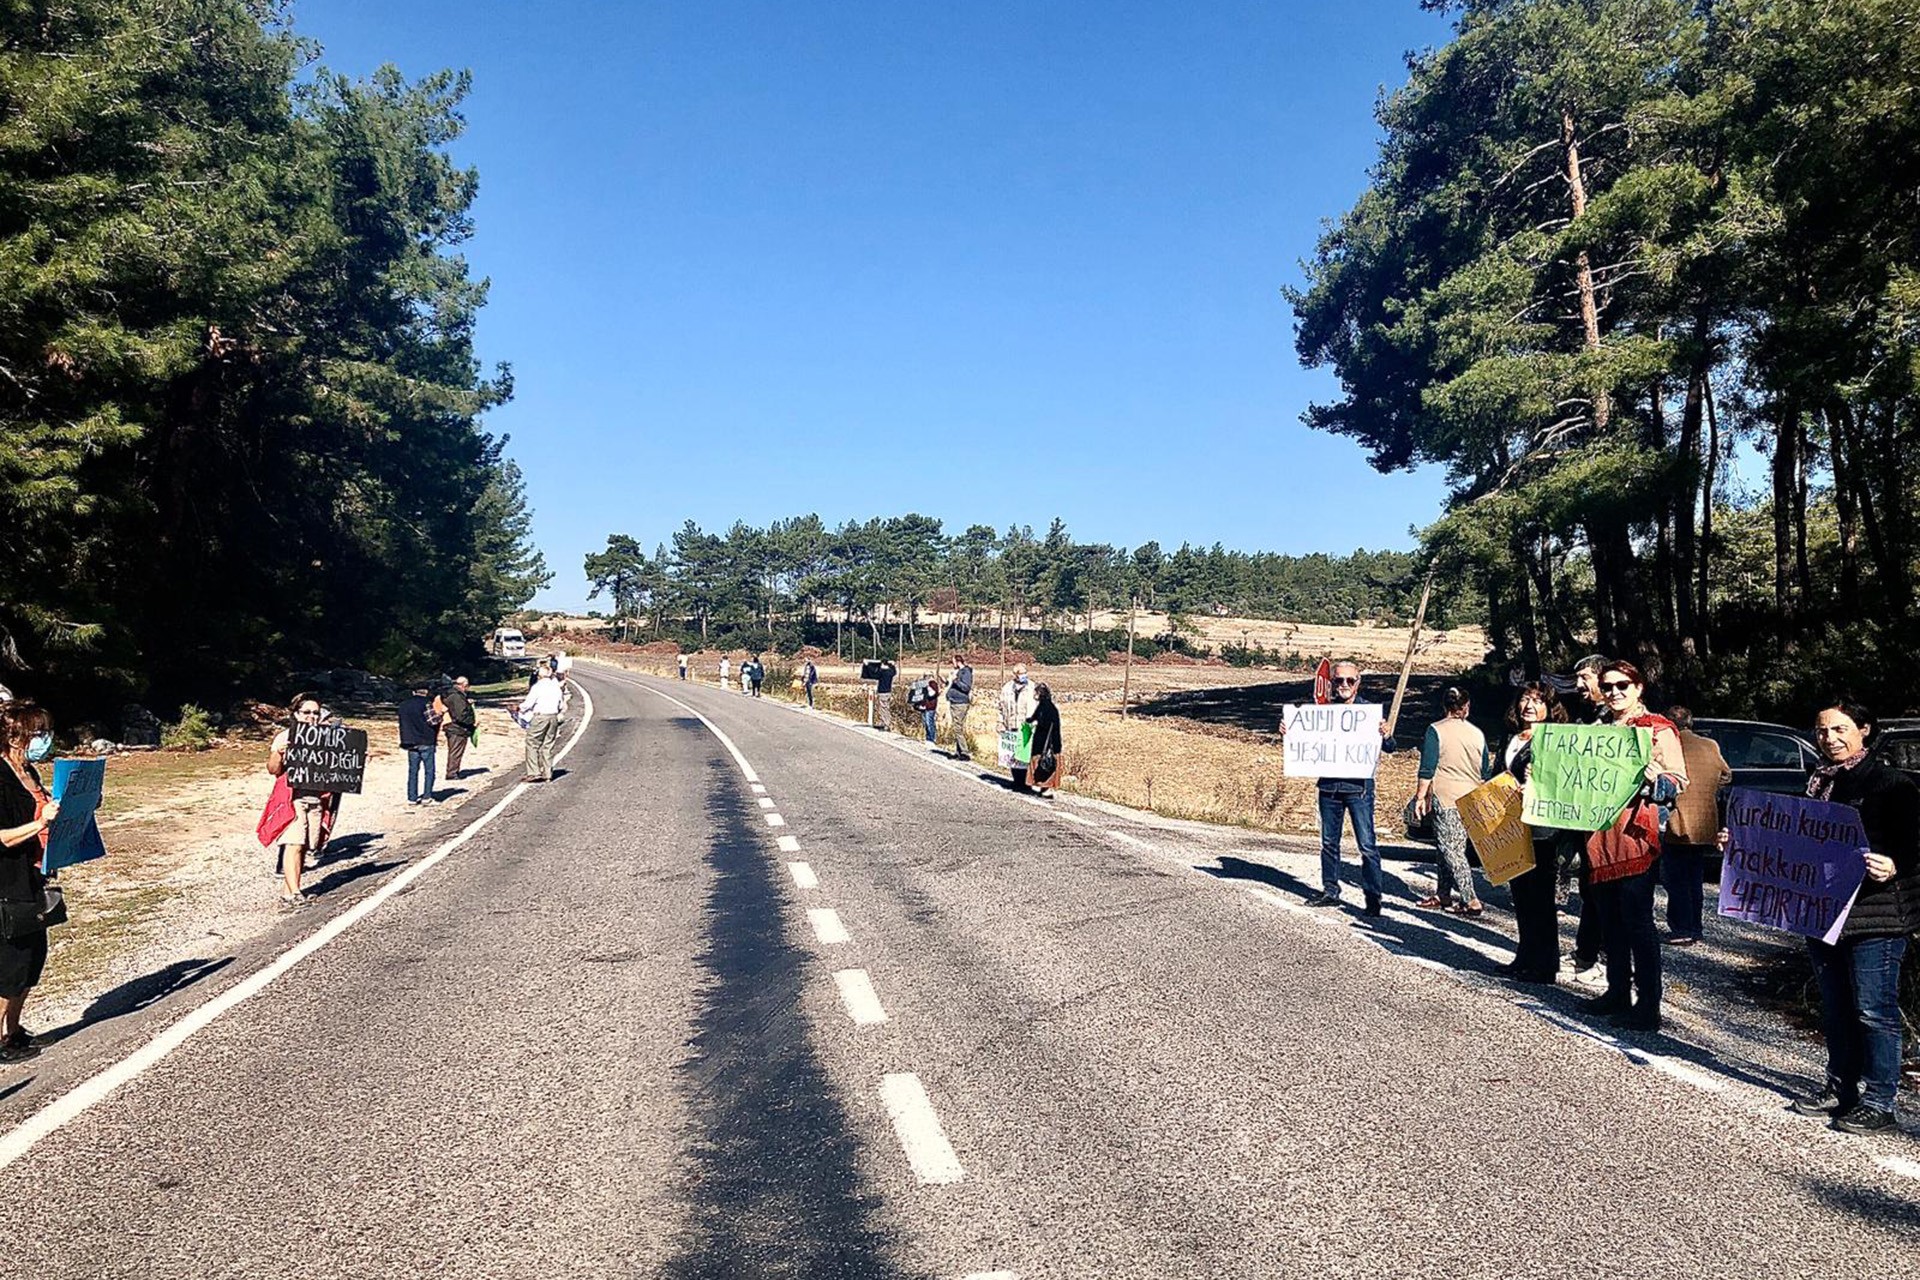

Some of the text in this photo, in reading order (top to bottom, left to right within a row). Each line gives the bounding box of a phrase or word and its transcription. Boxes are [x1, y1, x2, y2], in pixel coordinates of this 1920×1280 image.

[1289, 707, 1367, 732] AYIYI ÖP
[1544, 732, 1639, 760] TARAFSIZ
[1561, 764, 1619, 795] YARGI
[1524, 798, 1582, 821] HEMEN
[1728, 799, 1860, 847] Kurdun kuşun
